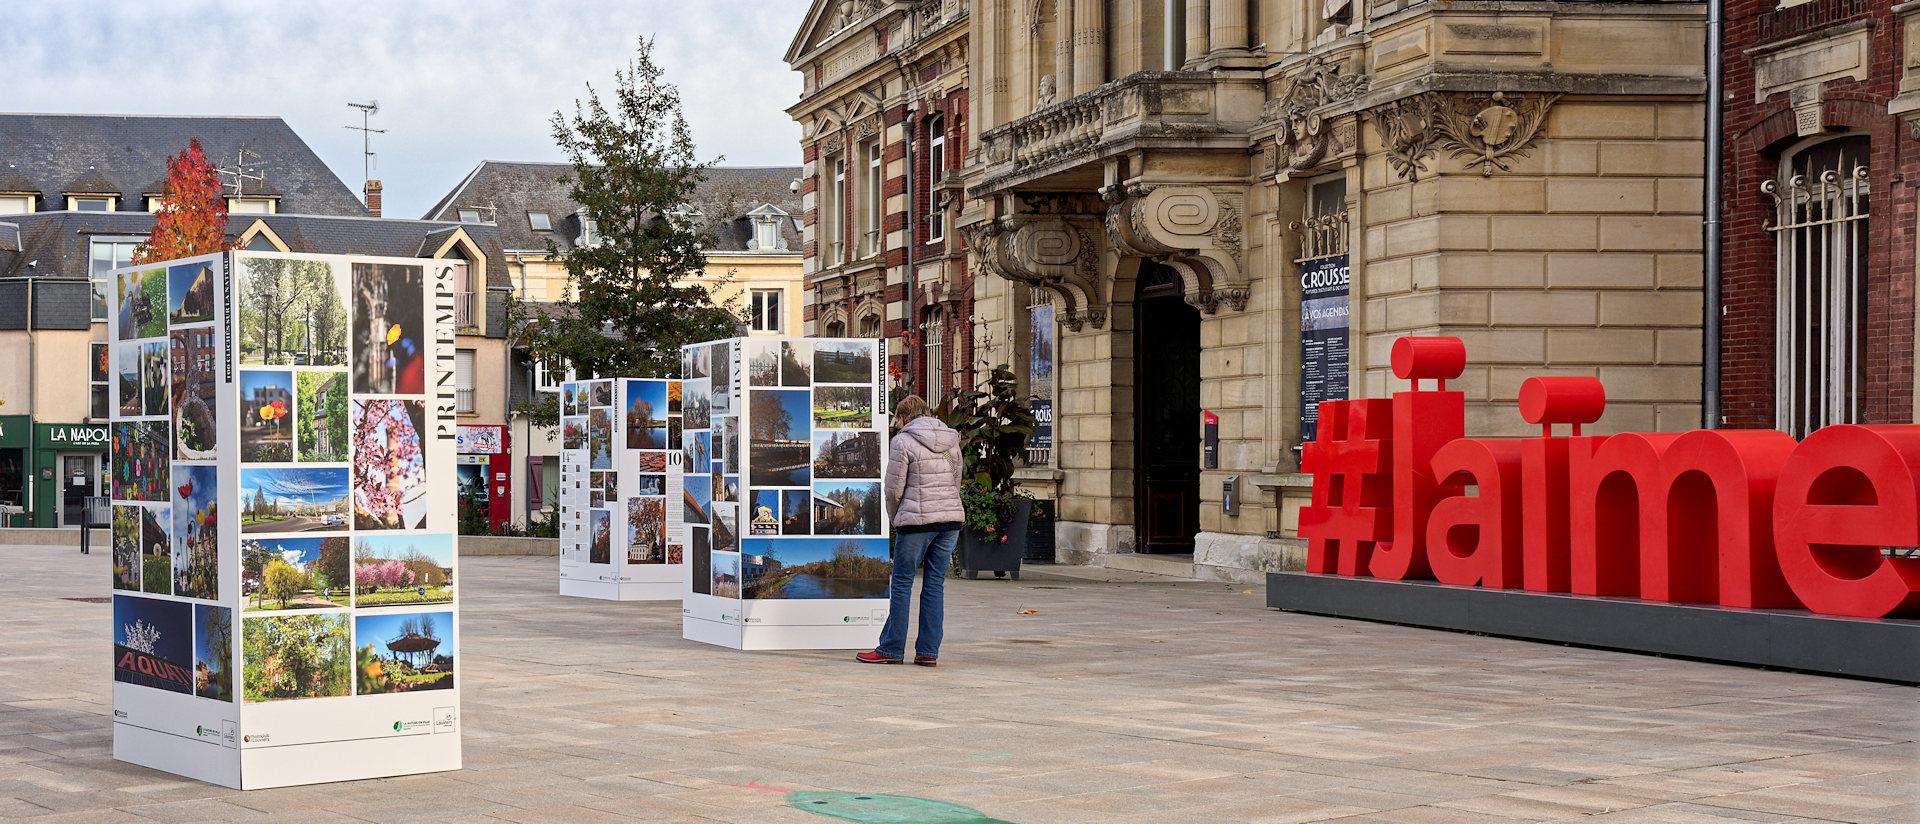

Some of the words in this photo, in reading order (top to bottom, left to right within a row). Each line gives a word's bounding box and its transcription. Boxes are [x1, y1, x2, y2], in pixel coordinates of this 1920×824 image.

[435, 266, 455, 441] PRINTEMPS
[51, 428, 66, 441] LA
[668, 452, 682, 466] 10
[1297, 336, 1920, 618] #Jaime
